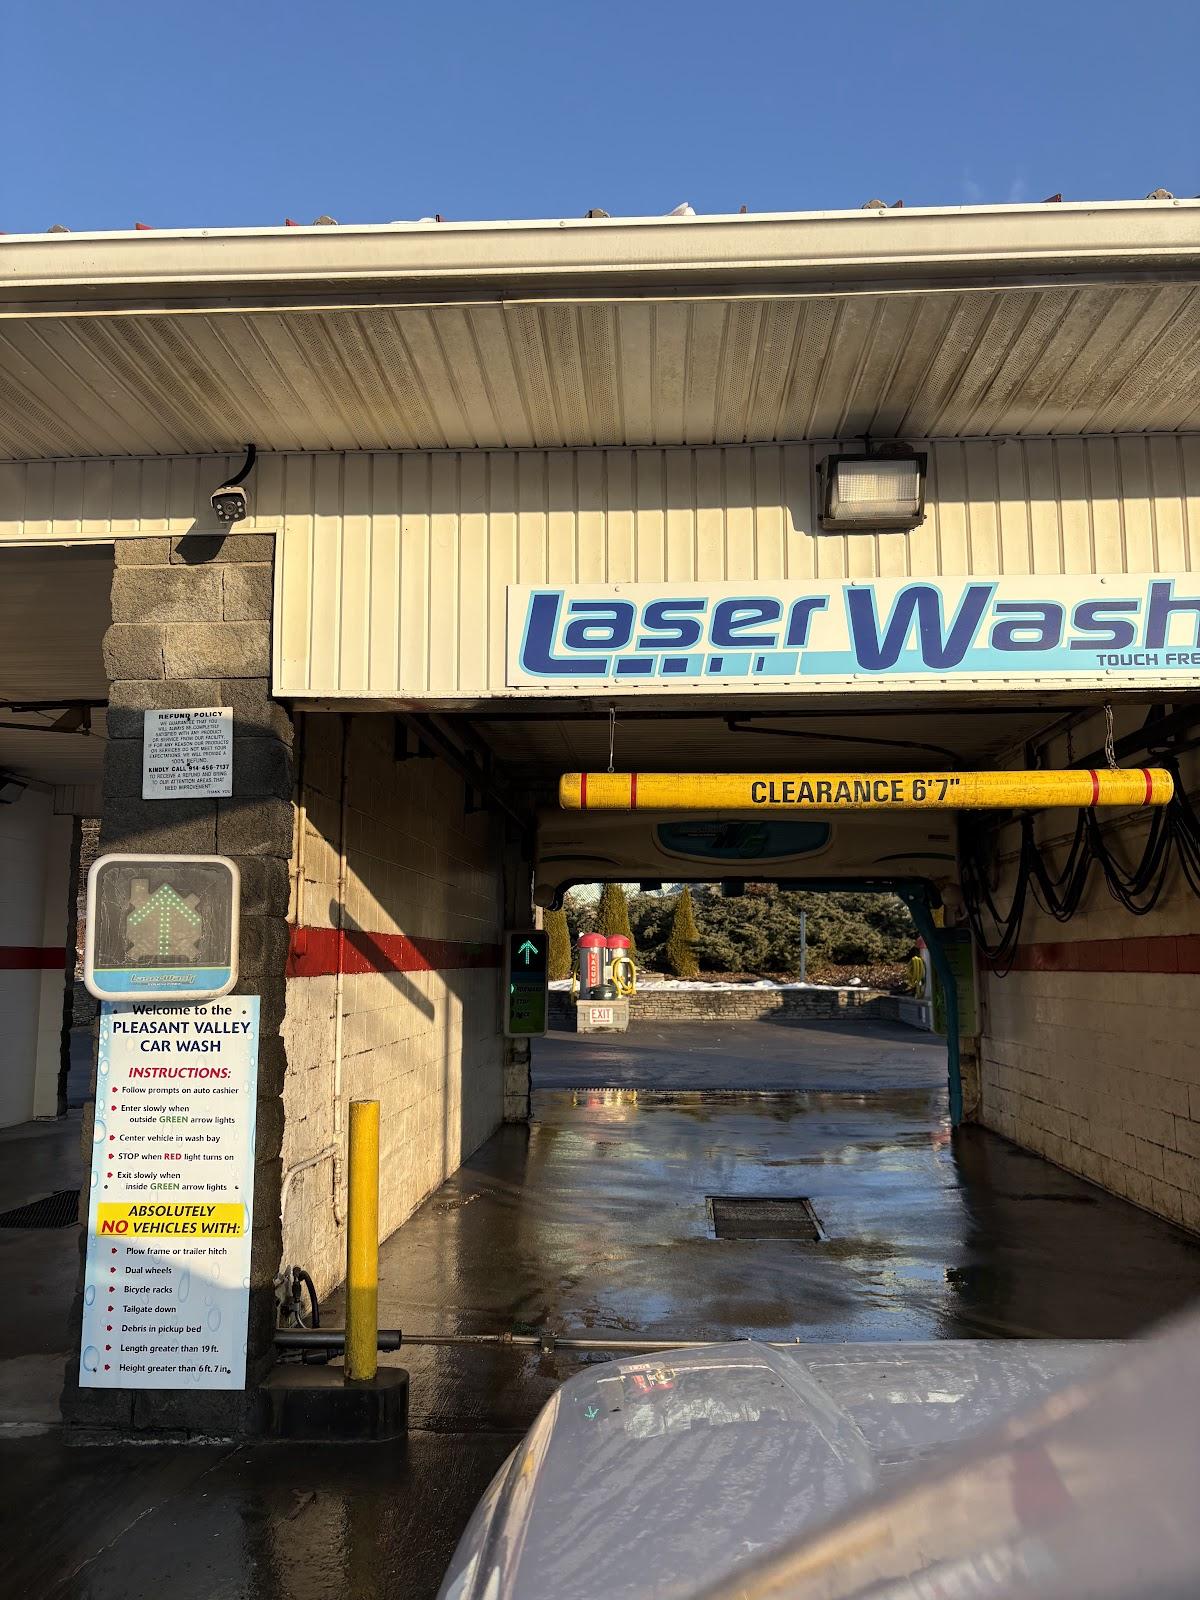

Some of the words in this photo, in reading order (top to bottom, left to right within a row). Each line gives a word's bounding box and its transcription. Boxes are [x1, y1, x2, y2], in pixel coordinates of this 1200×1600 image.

[1097, 654, 1158, 666] TOUCH
[752, 780, 904, 803] CLEARANCE
[912, 778, 960, 801] 6'7"
[133, 1005, 190, 1015] Welcome
[195, 1006, 207, 1015] to
[212, 1005, 232, 1015] the
[592, 1009, 610, 1018] EXIT
[113, 1022, 189, 1033] PLEASANT
[193, 1022, 250, 1033] VALLEY
[141, 1041, 170, 1052] CAR
[177, 1041, 221, 1052] WASH
[128, 1068, 231, 1078] INSTRUCTIONS:
[143, 1105, 166, 1113] slowly
[207, 1135, 220, 1143] bay
[184, 1153, 200, 1161] light
[128, 1206, 216, 1217] ABSOLUTELY
[101, 1220, 128, 1235] NO
[133, 1222, 197, 1233] VEHICLES
[201, 1222, 240, 1233] WITH:
[124, 1286, 150, 1294] Bicycle
[123, 1306, 152, 1314] Tailgate
[158, 1326, 184, 1334] pickup
[121, 1345, 147, 1353] Length
[120, 1364, 145, 1372] Height
